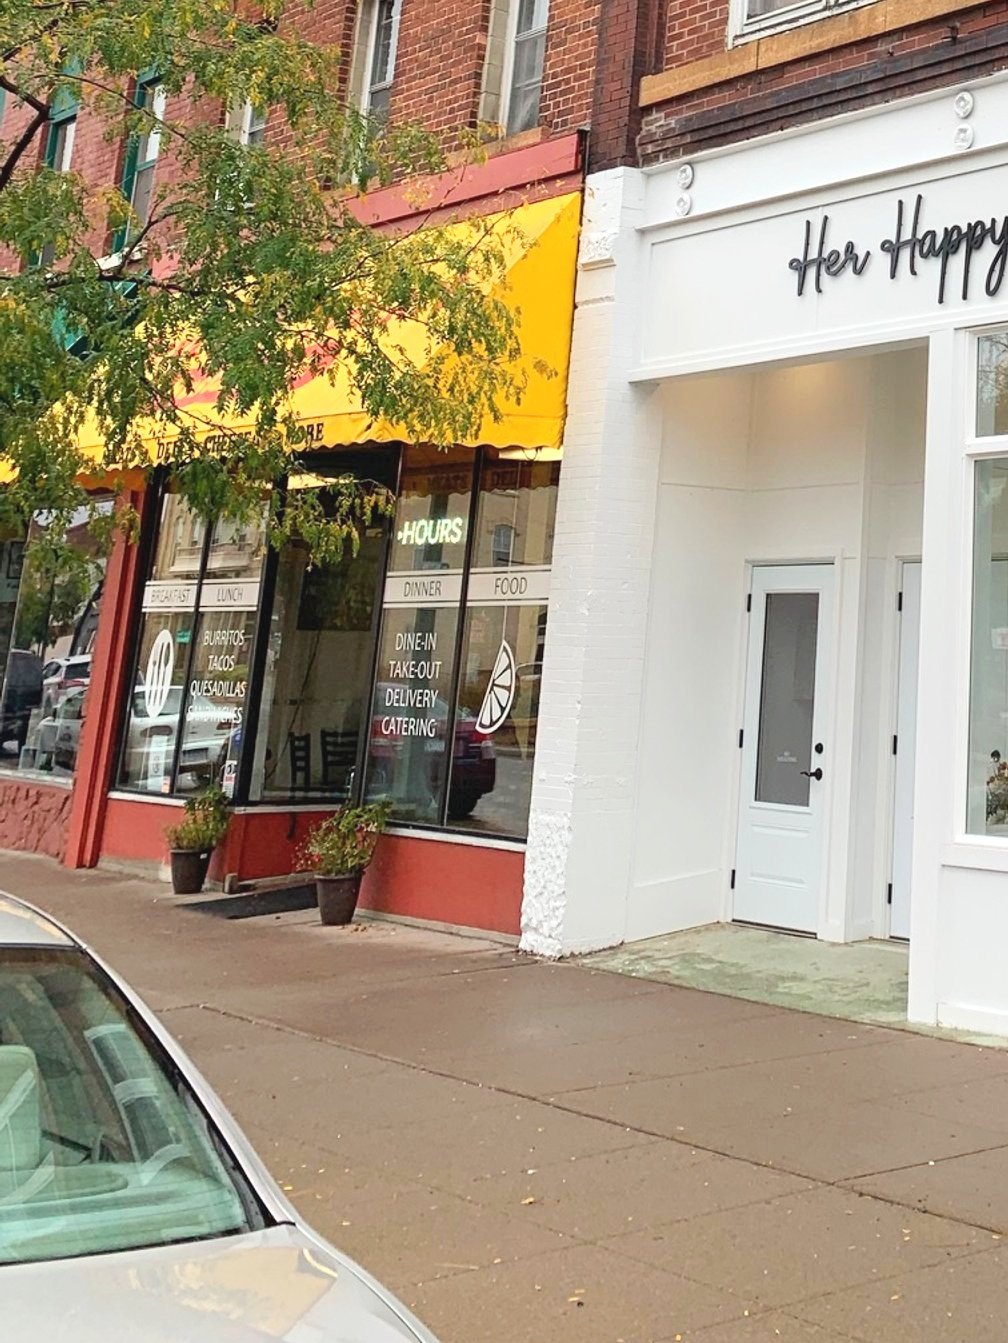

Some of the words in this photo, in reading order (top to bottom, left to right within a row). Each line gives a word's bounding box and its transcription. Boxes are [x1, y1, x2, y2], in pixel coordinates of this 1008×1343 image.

[788, 215, 870, 296] Her
[401, 517, 463, 545] HOURS
[403, 580, 442, 597] DINNER
[494, 577, 528, 595] FOOD
[151, 588, 191, 603] BREAKFAST
[217, 588, 244, 603] LUNCH
[203, 630, 246, 646] BURRITOS
[395, 632, 437, 651] DINE-IN
[208, 655, 235, 671] TACOS
[389, 661, 442, 679] TAKE-OUT
[190, 680, 247, 699] QUESADILLAS
[385, 688, 439, 708] DELIVERY
[381, 716, 437, 737] CATERING
